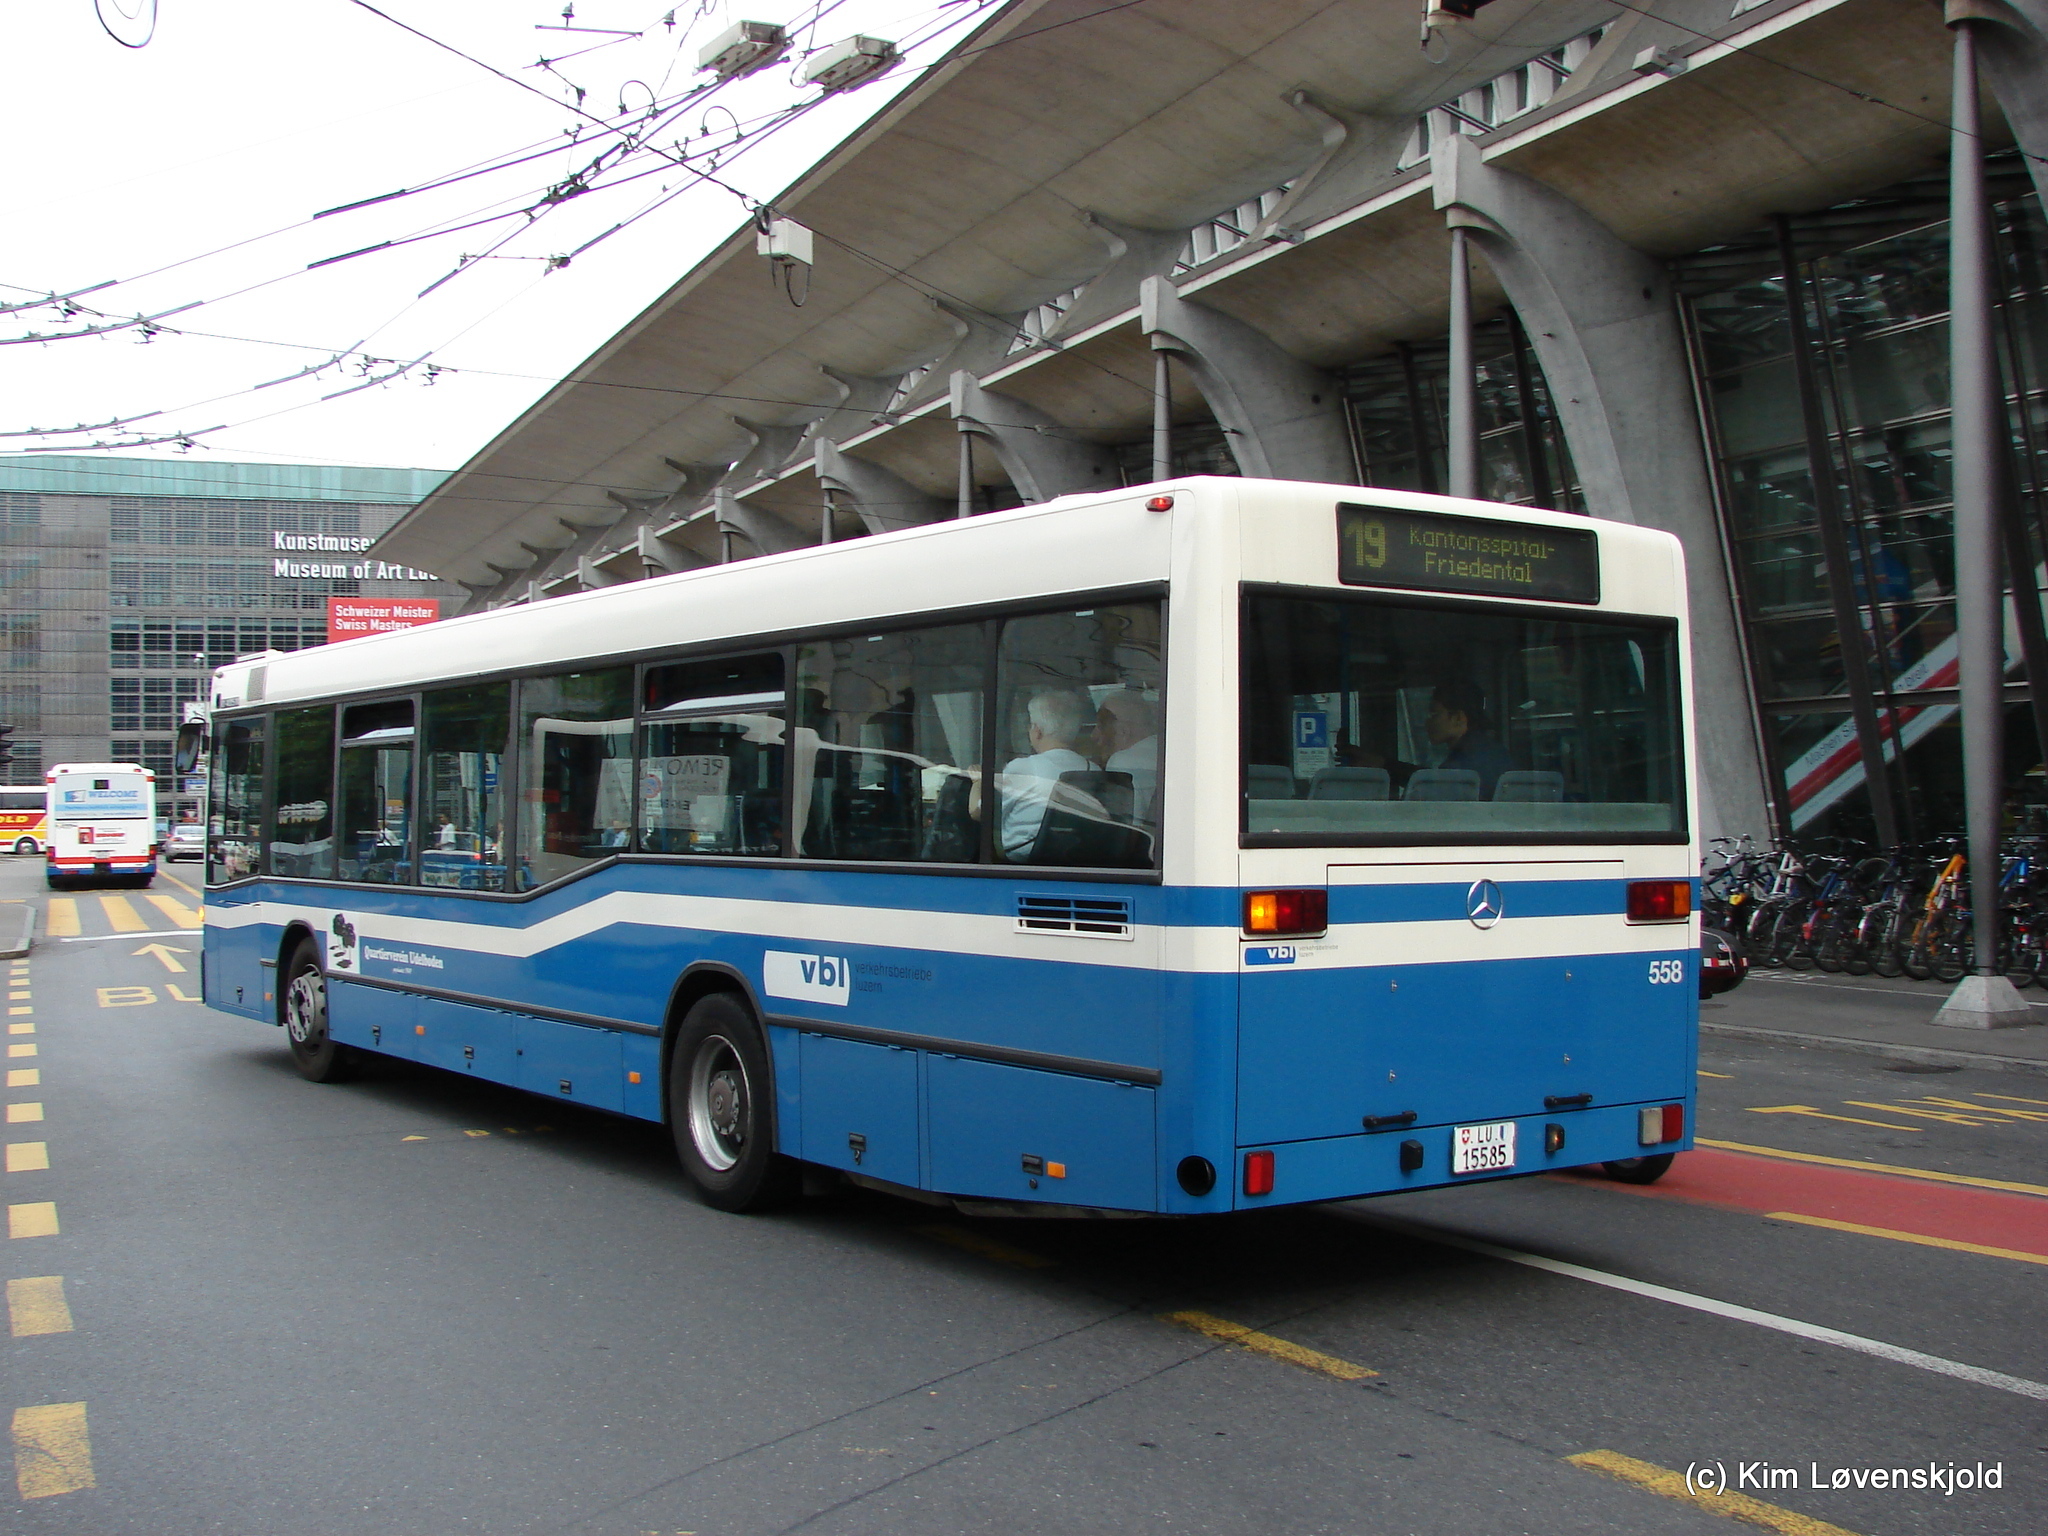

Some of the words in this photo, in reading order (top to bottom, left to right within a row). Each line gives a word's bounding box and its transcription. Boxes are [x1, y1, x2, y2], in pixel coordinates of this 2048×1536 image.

[274, 531, 376, 551] Kunstmuse
[1345, 517, 1387, 569] 19
[274, 559, 347, 578] Museum
[353, 561, 372, 578] of
[376, 561, 403, 580] Art
[1425, 551, 1533, 584] Friedental
[335, 605, 391, 618] Schweizer
[393, 606, 434, 618] Meister
[335, 618, 367, 630] Swiss
[1300, 717, 1316, 743] P
[87, 790, 139, 799] WELCOME
[1266, 946, 1295, 959] vbl
[800, 955, 845, 988] vbl
[854, 962, 933, 982] verkehrsbetriebe
[1648, 959, 1683, 985] 558
[855, 978, 883, 993] luzern
[1462, 1145, 1507, 1170] 15585
